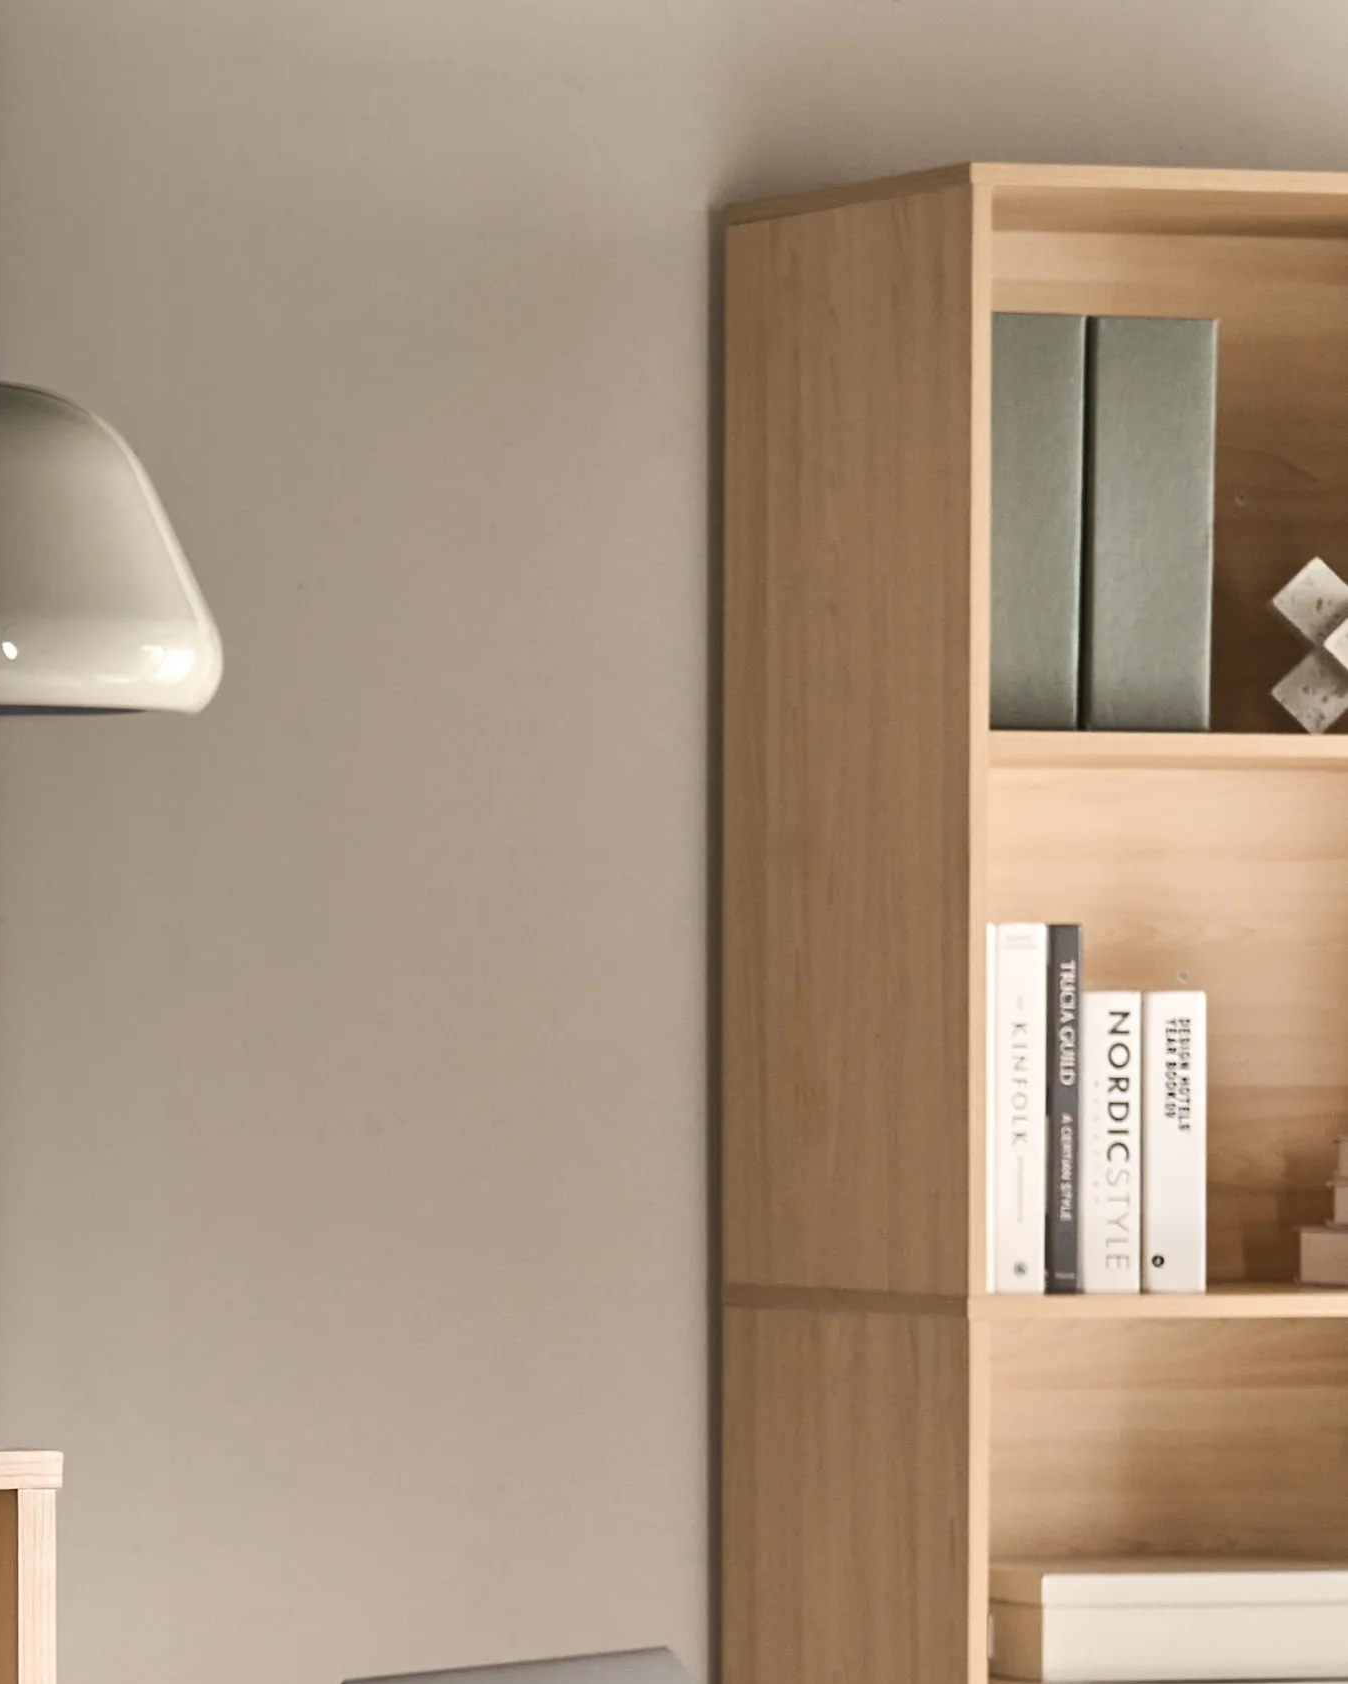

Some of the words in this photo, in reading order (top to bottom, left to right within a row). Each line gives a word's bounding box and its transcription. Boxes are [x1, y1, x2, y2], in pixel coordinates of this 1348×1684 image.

[1165, 1018, 1178, 1055] YEAR
[1178, 1018, 1192, 1070] DESIGN
[1011, 1021, 1029, 1147] KINFOLK
[1165, 1061, 1178, 1099] BOOK
